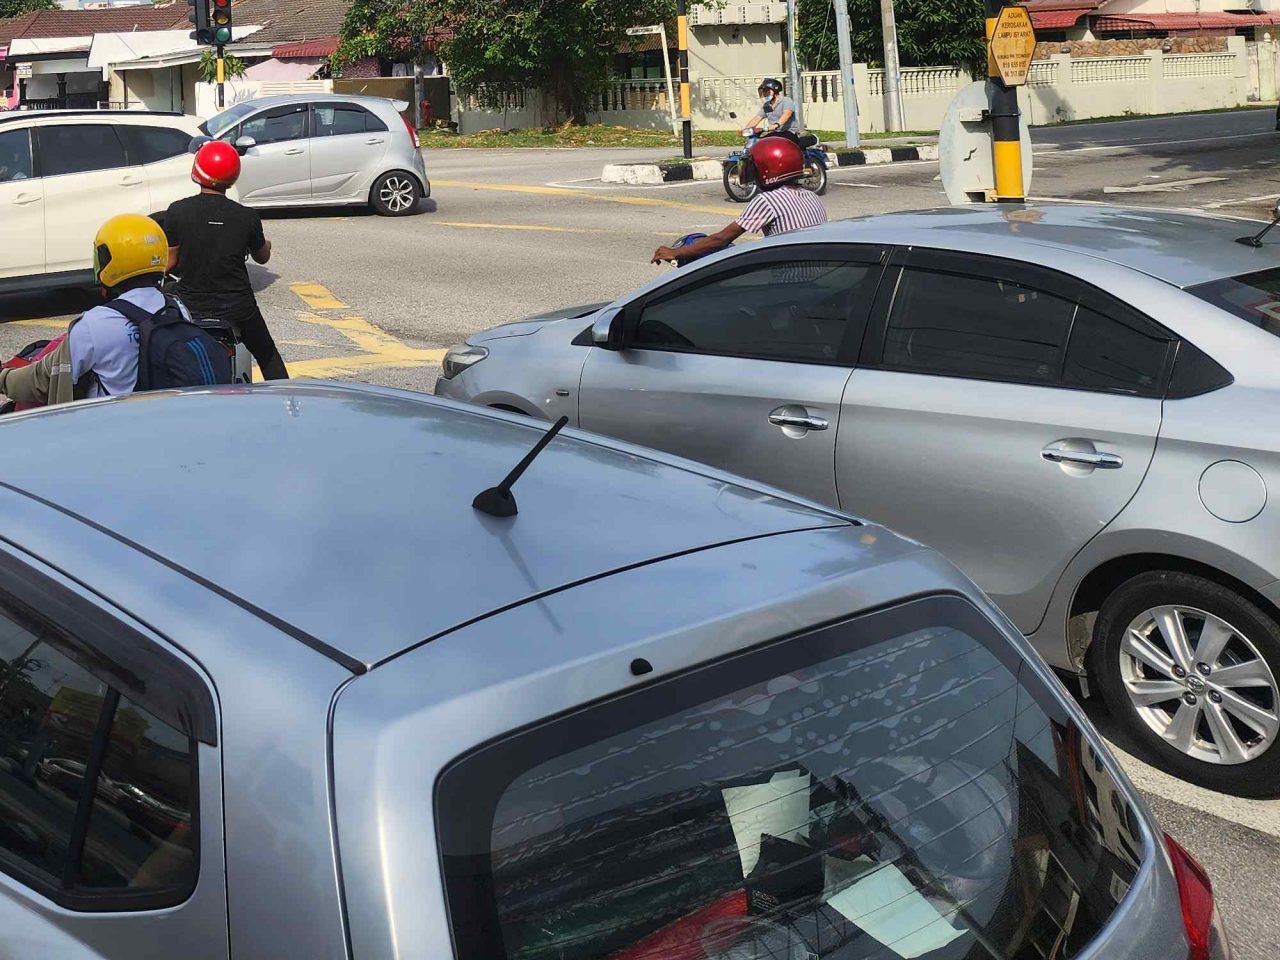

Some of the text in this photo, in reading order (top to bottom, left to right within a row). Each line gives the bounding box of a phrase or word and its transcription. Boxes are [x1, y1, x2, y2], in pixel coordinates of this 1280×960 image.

[1001, 21, 1028, 29] KEROSAKAN
[997, 30, 1032, 39] LAMPU ISYARAT
